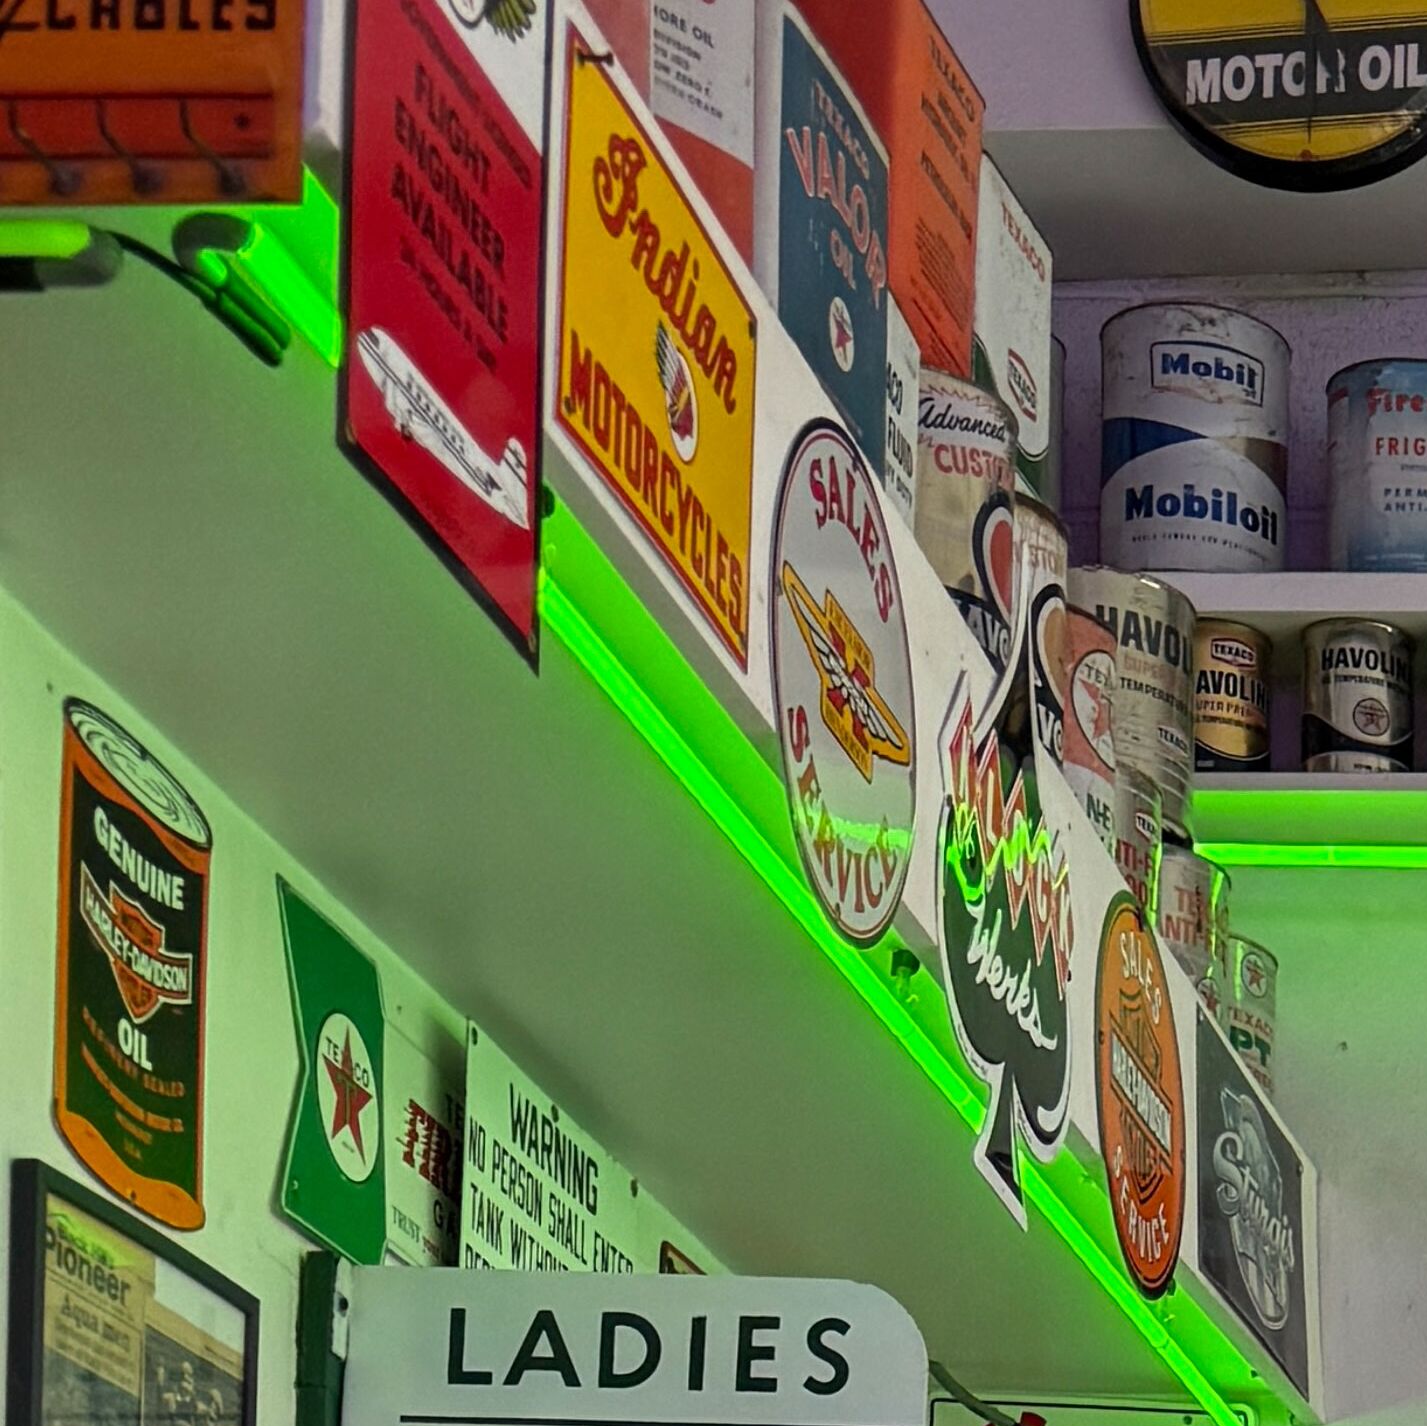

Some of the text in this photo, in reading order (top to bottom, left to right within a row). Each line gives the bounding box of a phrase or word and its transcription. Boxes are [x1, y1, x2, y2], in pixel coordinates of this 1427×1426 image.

[592, 132, 738, 416] Indian
[1161, 352, 1257, 391] Mobil
[570, 330, 745, 630] MOTORCYCLES
[1125, 484, 1277, 545] Mobiloil
[809, 456, 894, 624] SALES
[93, 805, 185, 911] GENUINE
[787, 704, 898, 914] SERVICE
[84, 885, 188, 993] HARLEY-DAVIDSON
[1119, 930, 1161, 1025] SALES
[116, 1017, 154, 1071] OIL
[468, 1115, 588, 1266] NO PERSON SHALL
[508, 1081, 599, 1217] WARNING
[1112, 1143, 1171, 1263] SERVICE
[1213, 1130, 1296, 1273] Sturgis
[45, 1221, 132, 1308] Pioneer
[470, 1182, 504, 1256] TANK
[446, 1307, 852, 1396] LADIES
